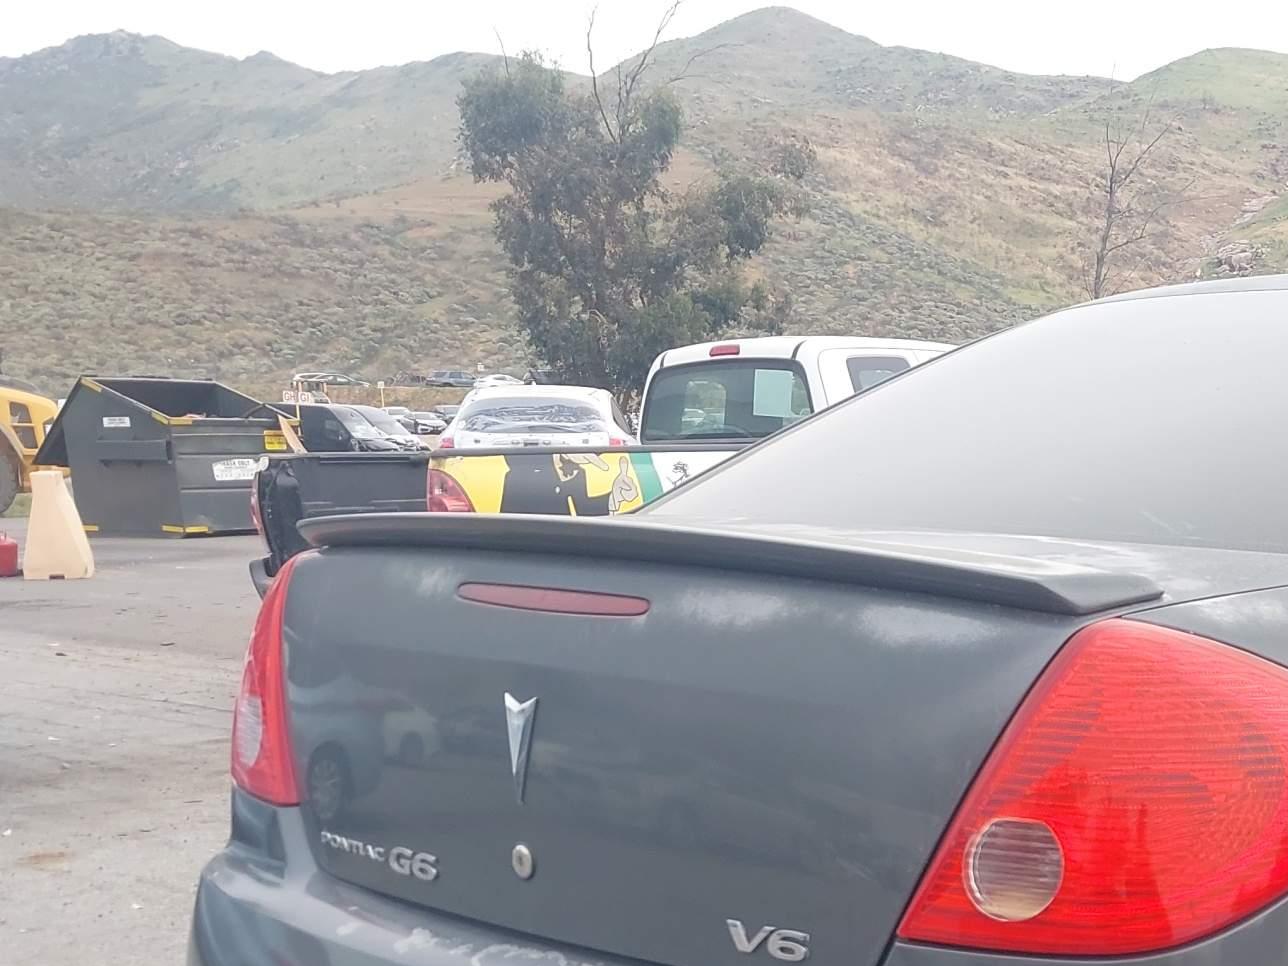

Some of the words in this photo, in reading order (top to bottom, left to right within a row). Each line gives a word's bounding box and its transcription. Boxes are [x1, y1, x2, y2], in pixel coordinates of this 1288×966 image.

[321, 831, 385, 861] PONTIAC
[388, 846, 437, 880] G6
[726, 918, 809, 961] V6
